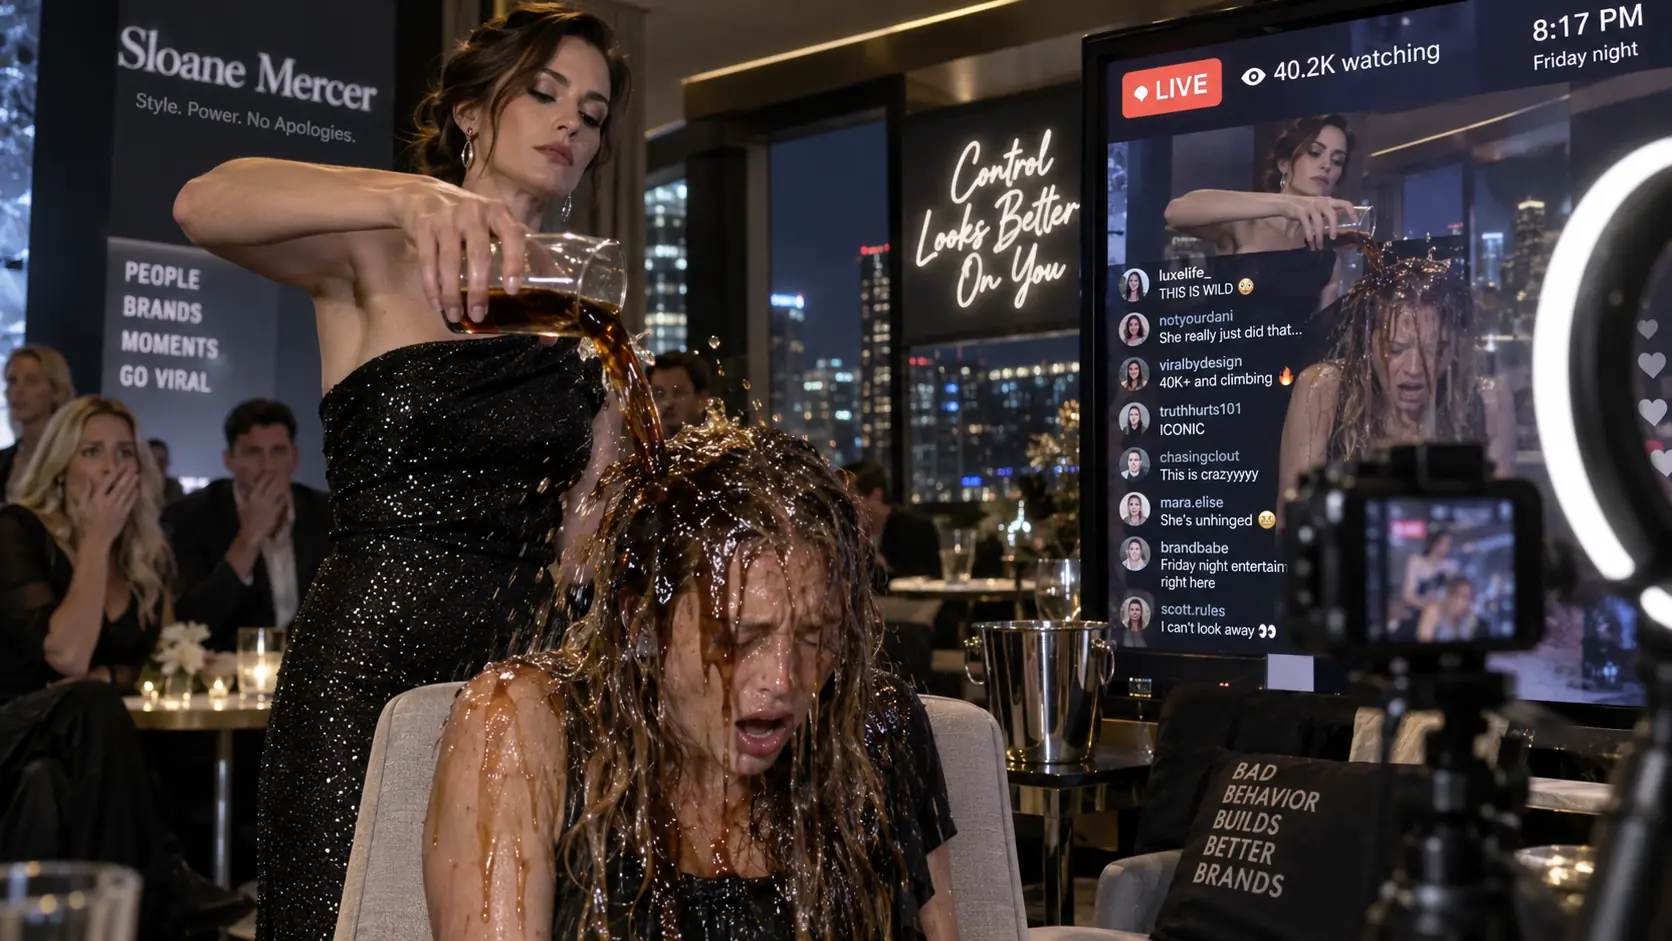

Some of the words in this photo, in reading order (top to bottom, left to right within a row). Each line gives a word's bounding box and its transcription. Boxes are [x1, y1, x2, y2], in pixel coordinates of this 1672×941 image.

[1533, 12, 1589, 42] 8:17
[1600, 3, 1643, 32] PM
[1274, 54, 1336, 81] 40.2K
[1341, 43, 1440, 72] watching
[1534, 51, 1587, 71] Friday
[1593, 41, 1639, 63] night
[118, 25, 246, 88] Sloane
[255, 52, 378, 112] Mercer
[1156, 73, 1208, 100] LIVE
[135, 93, 182, 115] Style.
[188, 101, 241, 125] Power.
[247, 111, 270, 129] No
[274, 116, 356, 143] Apologies.
[951, 129, 1054, 204] Control
[916, 203, 991, 267] Looks
[993, 184, 1080, 253] Better
[125, 261, 201, 290] PEOPLE
[957, 252, 1002, 308] On
[1011, 242, 1066, 309] You
[1159, 266, 1211, 281] luxelife_
[1159, 286, 1185, 299] THIS
[1189, 285, 1200, 298] IS
[1203, 283, 1233, 296] WILD
[123, 295, 202, 324] BRANDS
[1159, 310, 1233, 327] notyourdani
[1159, 331, 1182, 344] She
[1185, 329, 1217, 344] really
[1219, 328, 1241, 343] just
[1245, 325, 1264, 338] did
[1267, 324, 1302, 337] that...
[121, 330, 219, 359] MOMENTS
[1159, 356, 1242, 372] viralbydesign
[119, 364, 148, 387] GO
[154, 368, 212, 393] VIRAL
[1159, 375, 1191, 389] 40K+
[1194, 374, 1217, 387] and
[1220, 372, 1273, 388] climbing
[1159, 402, 1241, 417] truthhurts101
[1160, 422, 1205, 436] ICONIC
[1160, 450, 1240, 465] chasingclout
[1160, 468, 1185, 481] This
[1188, 468, 1198, 481] is
[1160, 496, 1224, 509] mara.elise
[1160, 514, 1192, 526] She's
[1195, 514, 1253, 529] unhinged
[1161, 541, 1229, 554] brandbabe
[1161, 558, 1196, 574] Friday
[1199, 560, 1228, 575] night
[1161, 576, 1188, 591] right
[1190, 577, 1215, 588] here
[1161, 604, 1225, 617] scott.rules
[1161, 621, 1164, 633] I
[1167, 621, 1195, 634] can't
[1197, 622, 1221, 635] look
[1224, 626, 1255, 639] away
[1232, 762, 1277, 781] BAD
[1222, 784, 1320, 812] BEHAVIOR
[1212, 809, 1282, 835] BUILDS
[1203, 835, 1276, 865] BETTER
[1192, 862, 1285, 898] BRANDS
